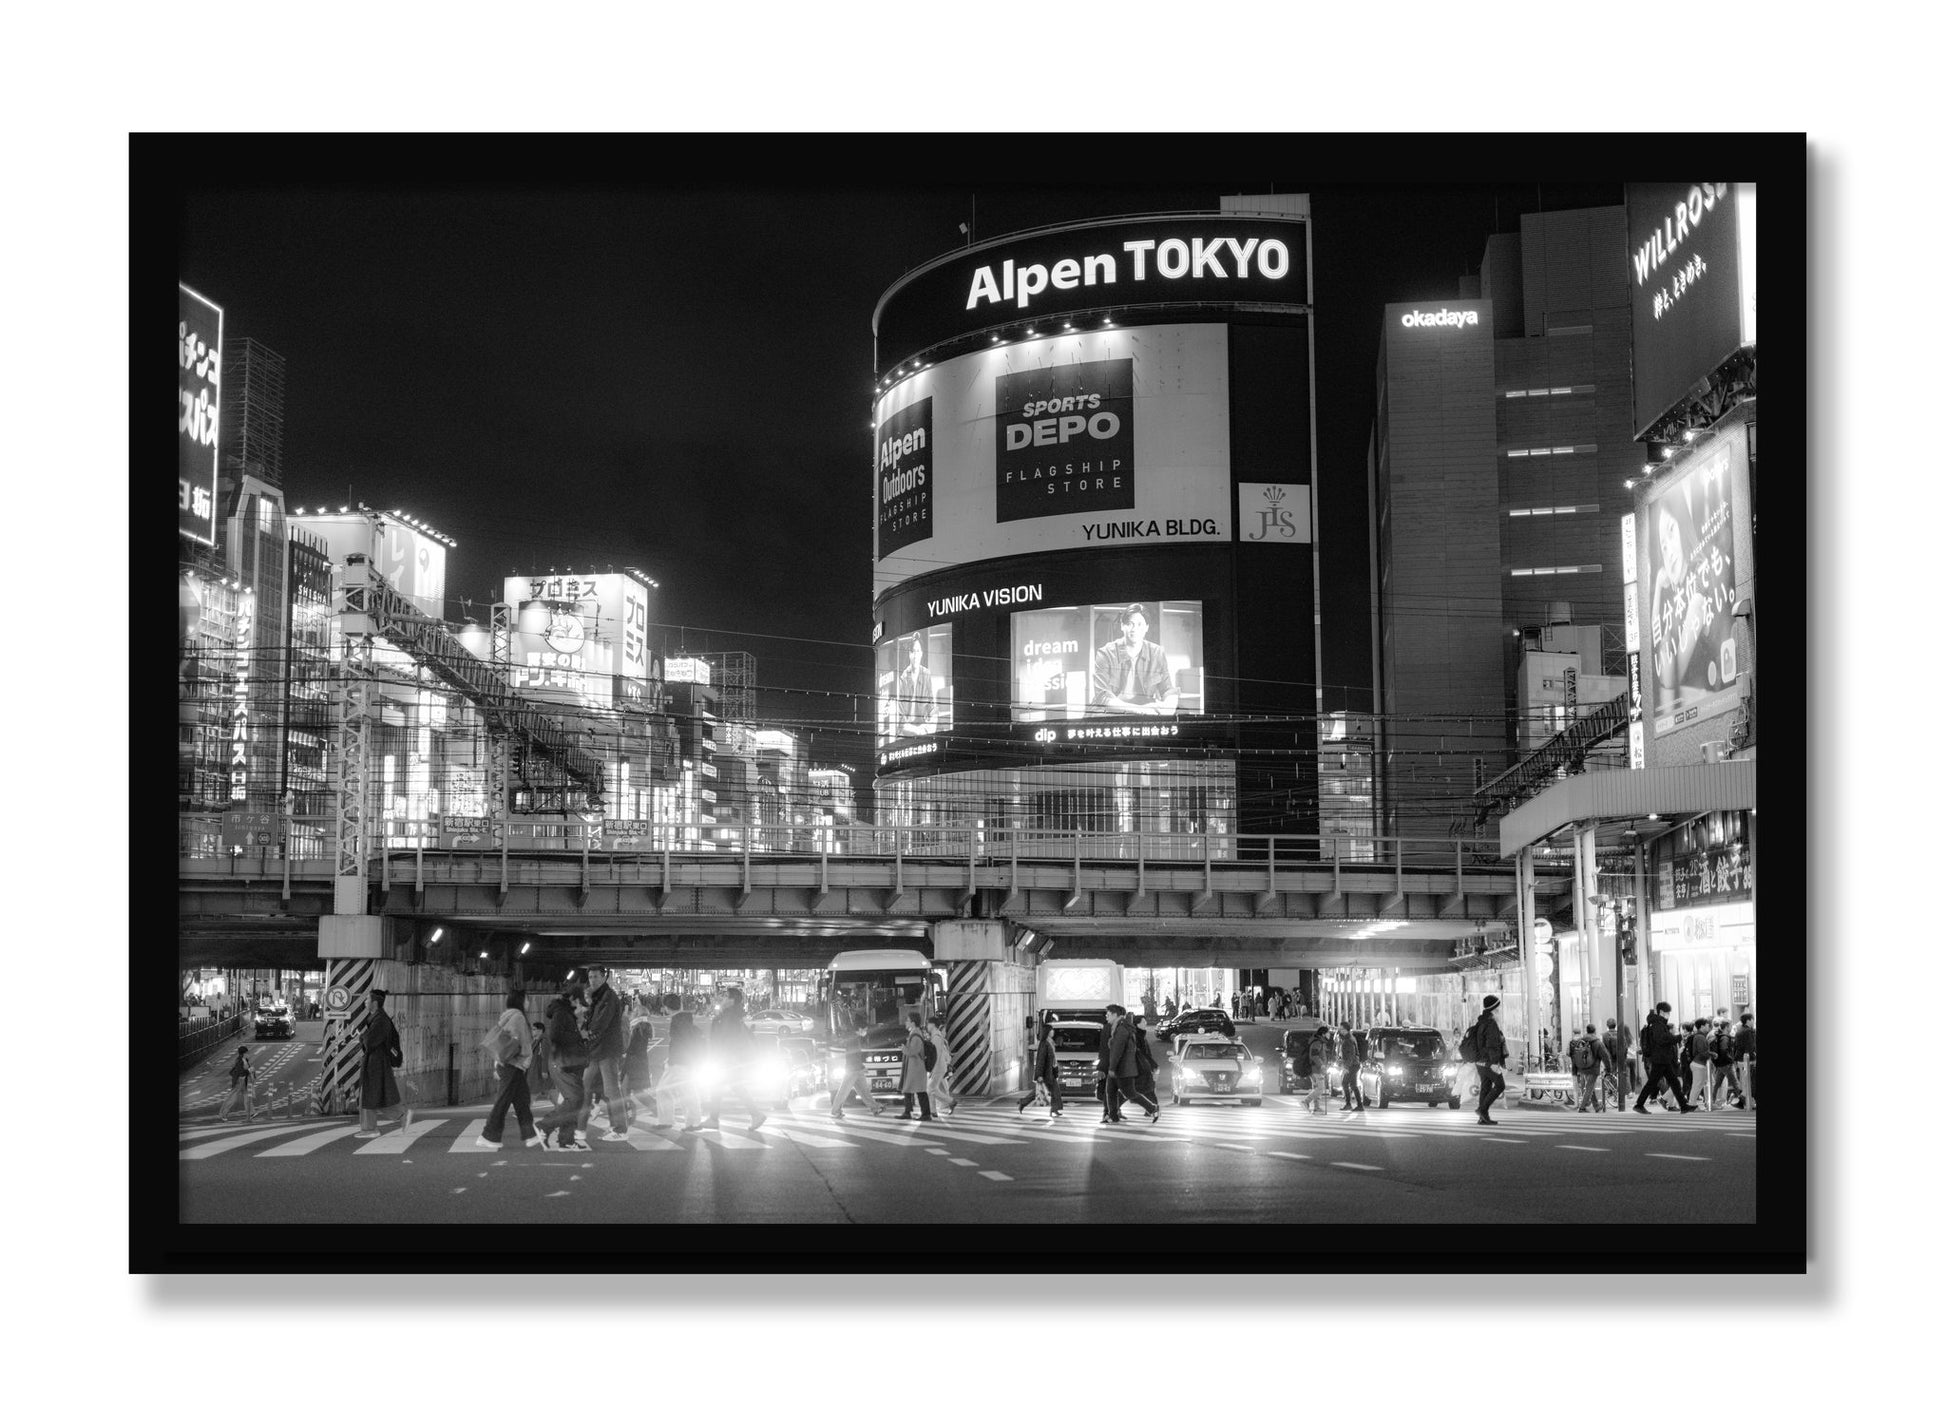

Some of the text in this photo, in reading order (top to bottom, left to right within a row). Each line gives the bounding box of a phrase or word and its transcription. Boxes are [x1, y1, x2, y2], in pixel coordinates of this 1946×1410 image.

[966, 237, 1290, 310] Alpen TOKYO
[1401, 308, 1479, 329] okadaya
[1022, 394, 1101, 418] SPORTS
[1006, 411, 1121, 451] DEPO
[880, 427, 926, 472] Alpen
[1006, 459, 1121, 483] FLAGSHIP
[882, 464, 926, 504] Outdoors
[1047, 477, 1121, 494] STORE
[880, 492, 926, 525] FLAGSHIP
[892, 512, 926, 531] STORE
[1082, 518, 1221, 541] YUNIKA BLDG.
[298, 584, 328, 605] SHISHA
[529, 578, 599, 600] プロミス
[927, 583, 1043, 618] YUNIKA VISION
[1023, 638, 1079, 657] dream
[1034, 725, 1179, 744] dip 夢を叶える仕事に出会おう
[444, 817, 490, 828] 新宿駅東口
